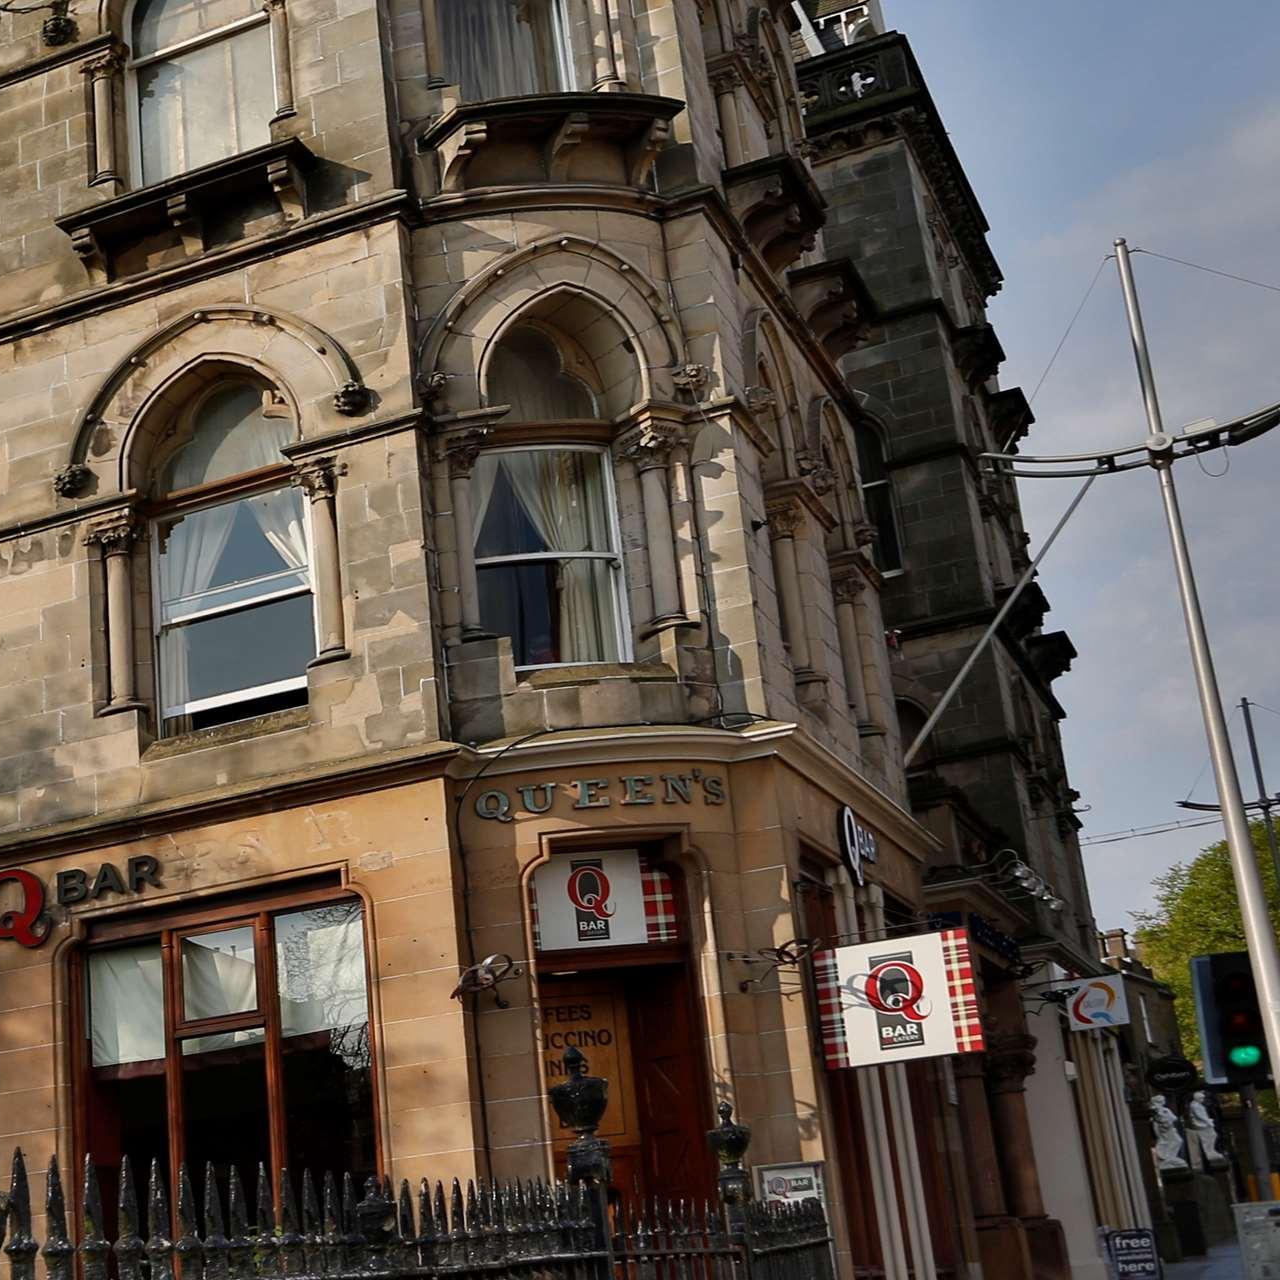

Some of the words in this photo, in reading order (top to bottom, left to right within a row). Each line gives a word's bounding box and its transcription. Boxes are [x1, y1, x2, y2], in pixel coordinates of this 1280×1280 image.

[475, 768, 727, 823] QUEEN'S
[843, 806, 864, 887] Q
[56, 854, 162, 905] BAR
[567, 866, 616, 919] Q
[580, 921, 606, 931] BAR
[865, 961, 932, 1022] Q
[881, 1023, 918, 1038] BAR
[1115, 1236, 1151, 1249] free
[1119, 1262, 1155, 1272] here
